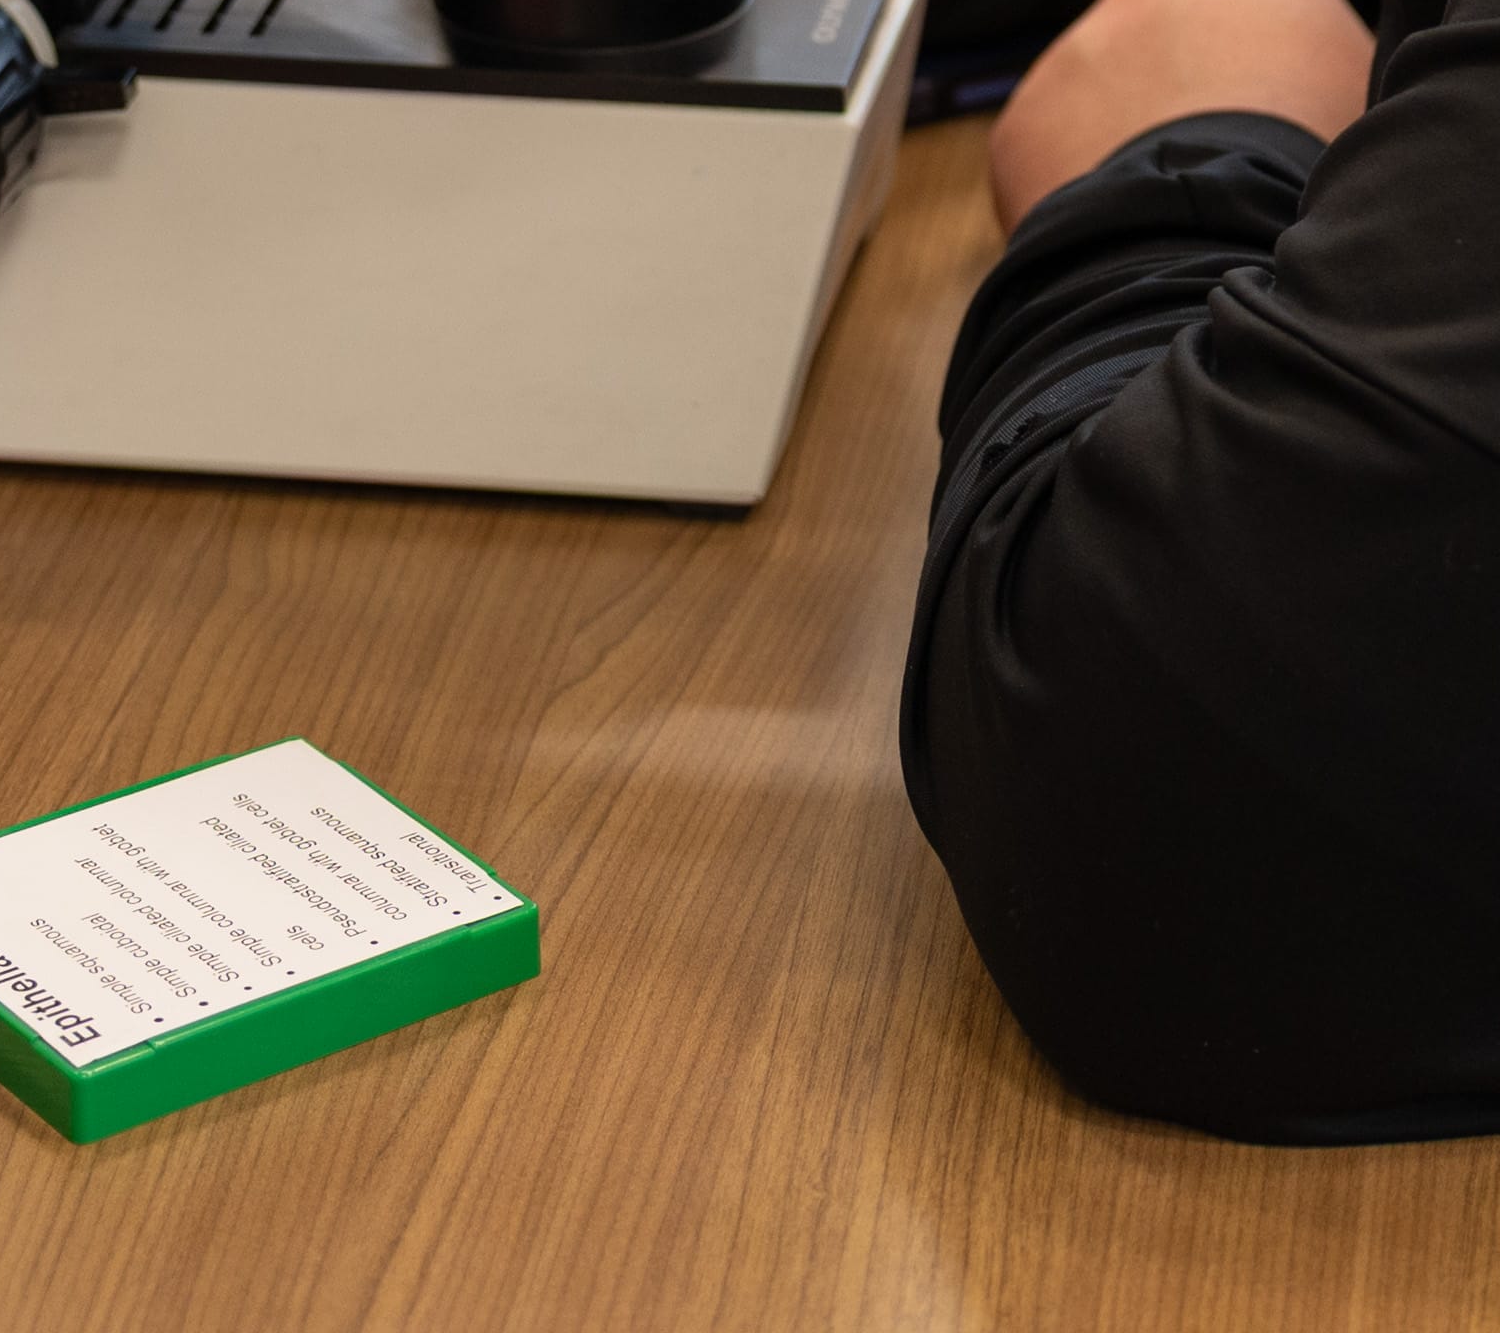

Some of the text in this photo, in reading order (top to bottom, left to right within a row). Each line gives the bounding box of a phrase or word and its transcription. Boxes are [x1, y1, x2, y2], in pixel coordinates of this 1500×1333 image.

[92, 822, 283, 968] Simple columnar with goblet
[198, 815, 368, 938] Pseudostratified ciliated
[232, 791, 409, 922] columnar with goblet cells
[309, 805, 449, 910] Stratified squamous
[399, 831, 489, 894] Transitional
[30, 916, 153, 1015] Simple squamous
[74, 857, 240, 983] Simple ciliated columnar
[81, 912, 197, 999] Simple cuboidal
[286, 924, 325, 952] cells
